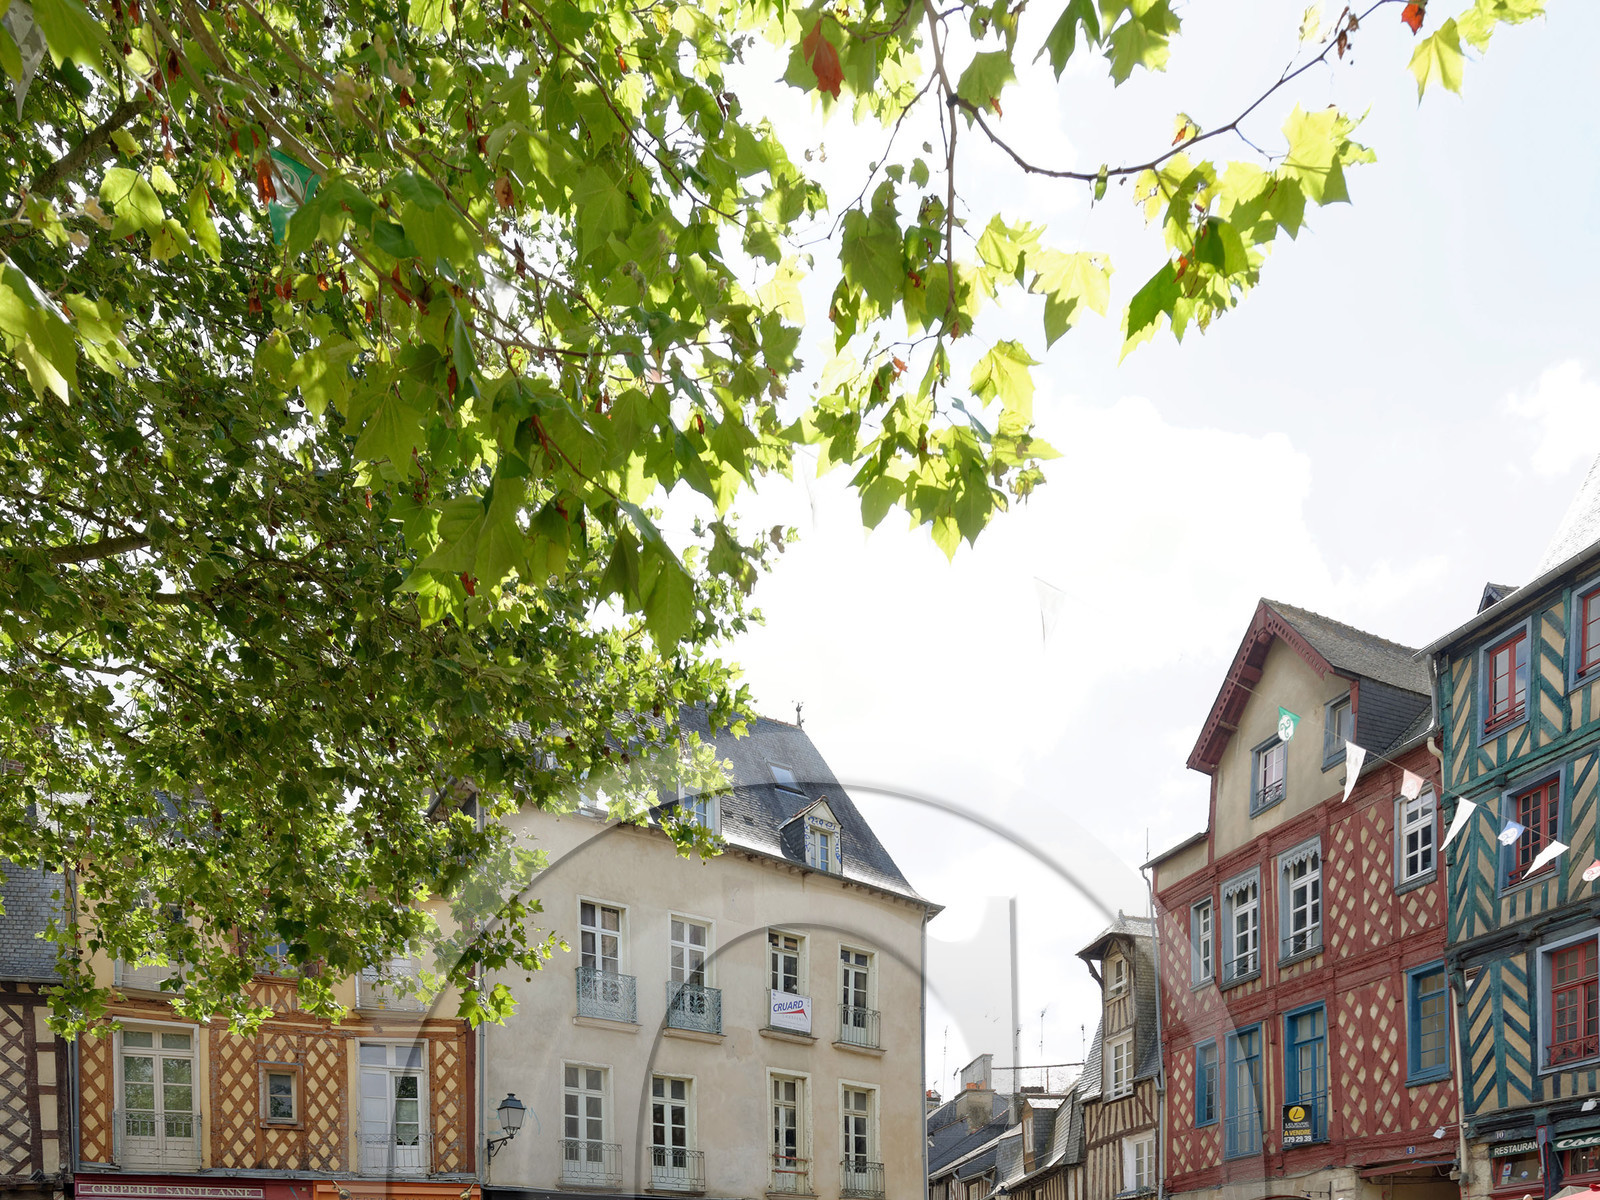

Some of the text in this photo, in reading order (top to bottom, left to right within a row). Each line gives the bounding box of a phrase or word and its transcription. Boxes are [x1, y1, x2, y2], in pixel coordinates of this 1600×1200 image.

[773, 1000, 803, 1012] CRUARD
[1496, 1131, 1504, 1139] 10
[1408, 1146, 1413, 1154] 9
[1494, 1141, 1538, 1156] RESTAURAN
[91, 1185, 251, 1196] CREPERIE SAINTE ANNE
